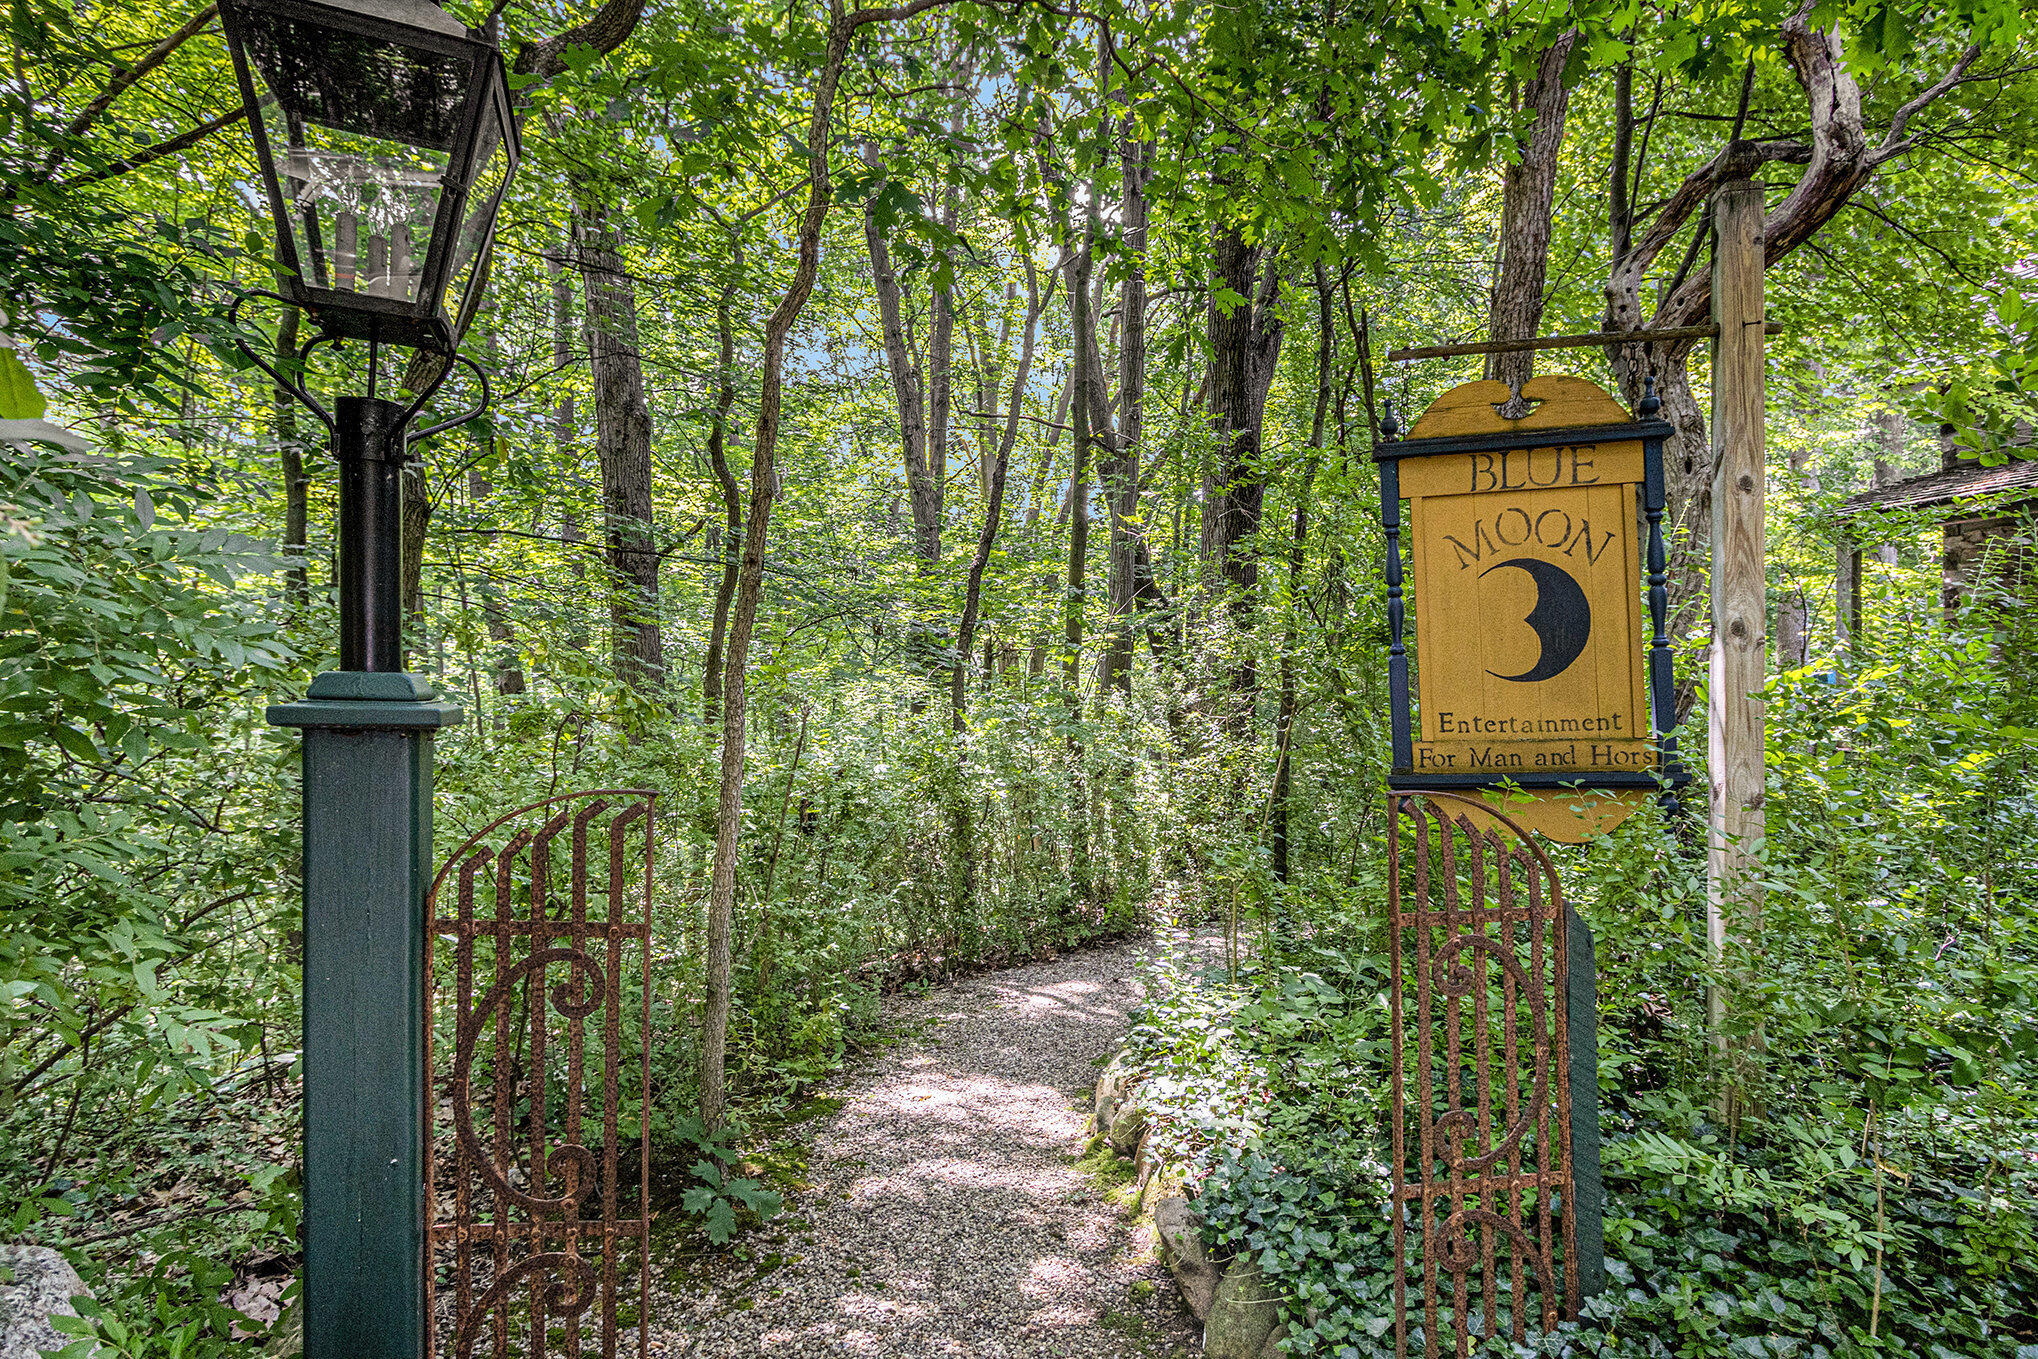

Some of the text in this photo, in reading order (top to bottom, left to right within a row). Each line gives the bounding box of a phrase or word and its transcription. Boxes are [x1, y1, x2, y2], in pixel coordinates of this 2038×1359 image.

[1469, 444, 1600, 492] BLUE
[1442, 507, 1616, 570] MOON
[1438, 711, 1622, 734] Entertainment
[1418, 748, 1456, 768] For
[1470, 747, 1523, 768] Man
[1534, 745, 1577, 766] and
